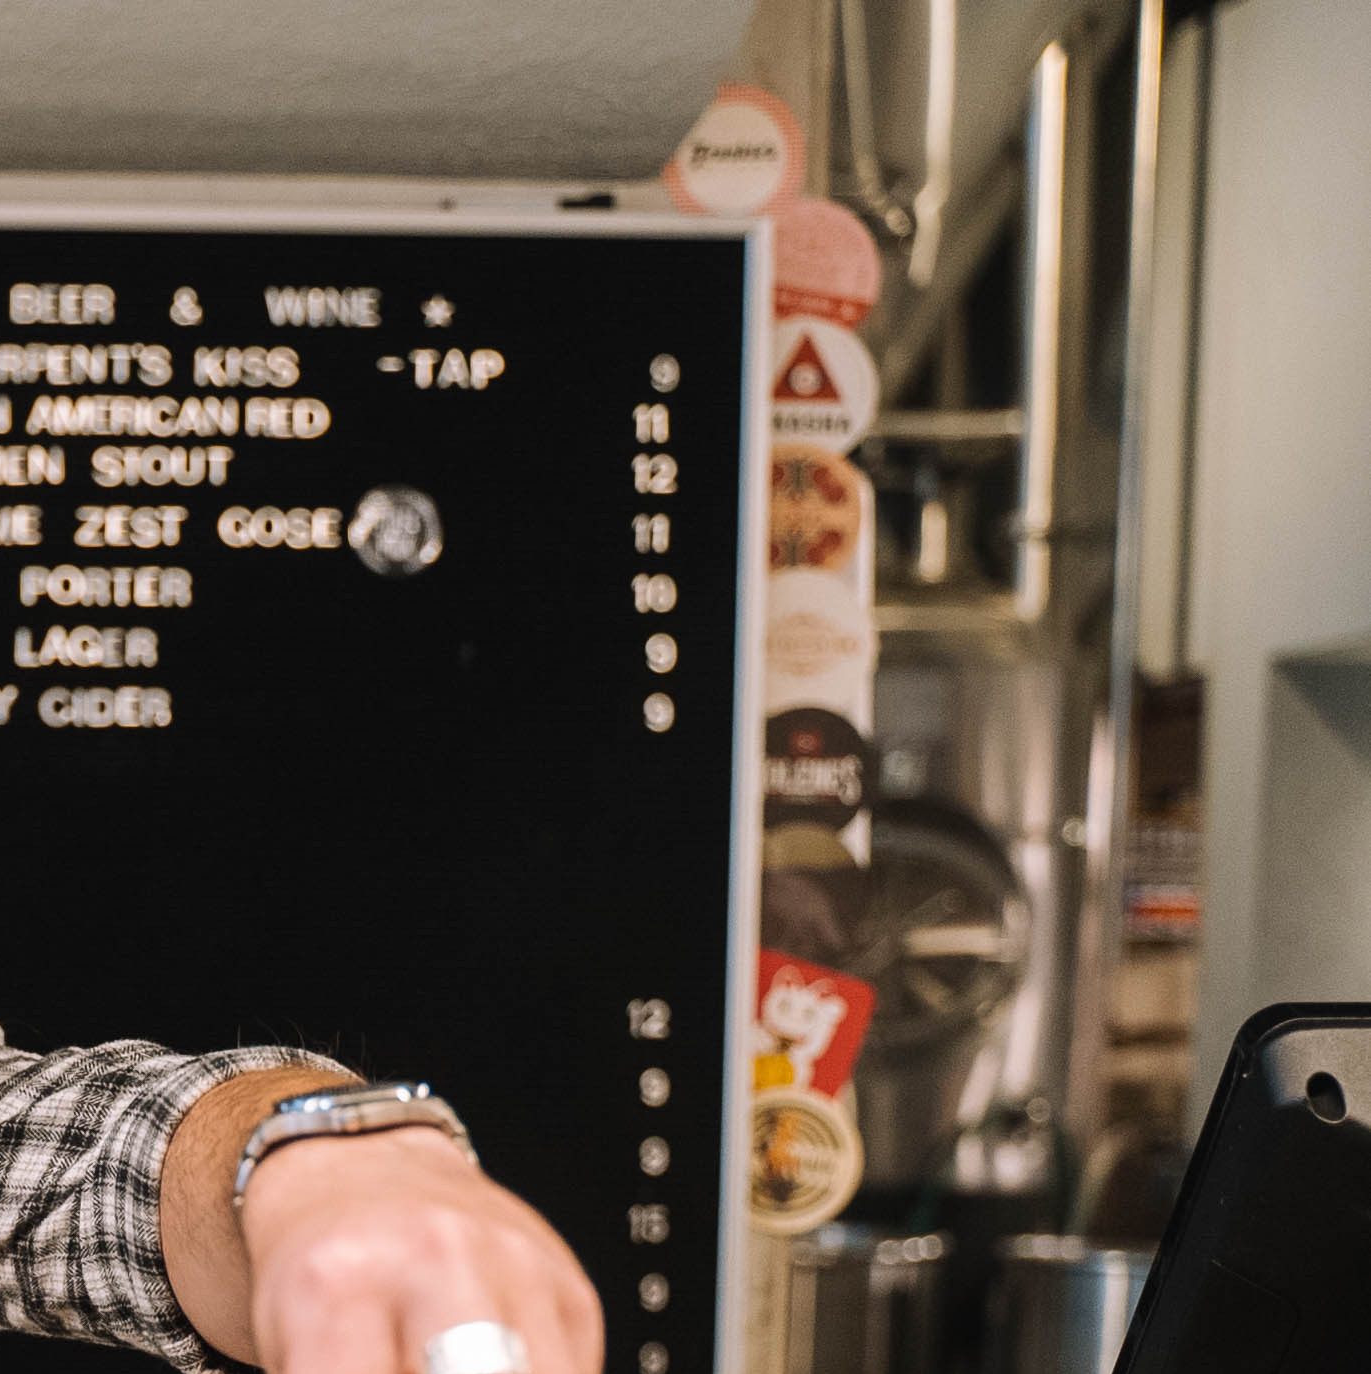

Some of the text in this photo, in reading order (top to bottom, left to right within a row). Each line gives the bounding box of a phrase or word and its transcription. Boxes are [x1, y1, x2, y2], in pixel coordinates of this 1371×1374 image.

[9, 283, 383, 328] BEER & WINE
[193, 346, 301, 388] KISS
[648, 353, 681, 393] 9
[25, 395, 240, 438] AMERICAN
[244, 397, 333, 440] RED
[631, 402, 670, 444] 11
[91, 445, 235, 488] STOUT
[631, 452, 678, 495] 12
[72, 504, 189, 549] ZEST
[216, 506, 344, 549] GOSE
[631, 512, 671, 554] 11
[19, 564, 194, 608] PORTER
[631, 572, 678, 614] 10
[13, 625, 159, 668] LAGER
[644, 632, 678, 674] 9
[38, 685, 174, 729] CIDER
[642, 691, 676, 733] 9
[626, 998, 672, 1039] 12
[638, 1066, 672, 1108] 9
[638, 1135, 671, 1177] 9
[637, 1272, 670, 1312] 9
